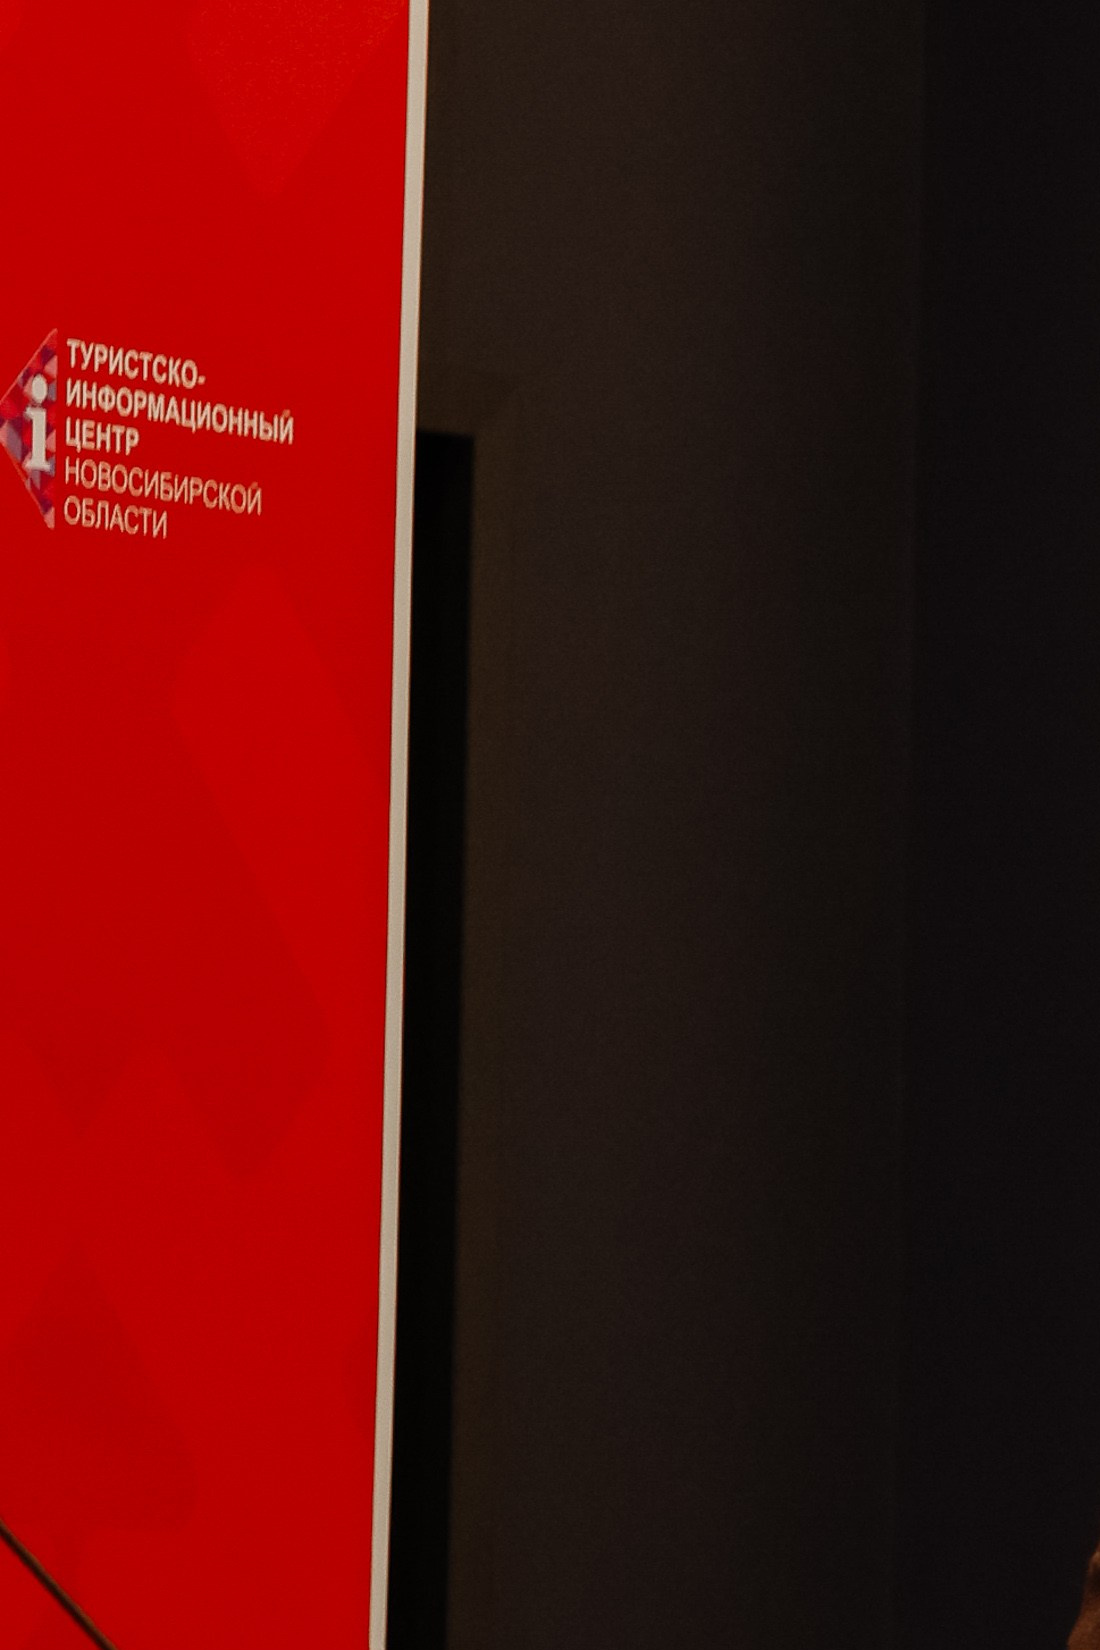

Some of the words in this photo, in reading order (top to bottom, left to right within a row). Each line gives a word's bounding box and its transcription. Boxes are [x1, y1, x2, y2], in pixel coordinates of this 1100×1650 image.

[66, 338, 206, 389] ТУРИСТСКО-
[64, 417, 139, 455] ЦЕНТР
[65, 377, 294, 445] ИНФОРМАЦИОННЫЙ
[64, 456, 262, 516] НОВОСИБИРСКОЙ
[63, 495, 168, 539] ОБЛАСТИ
